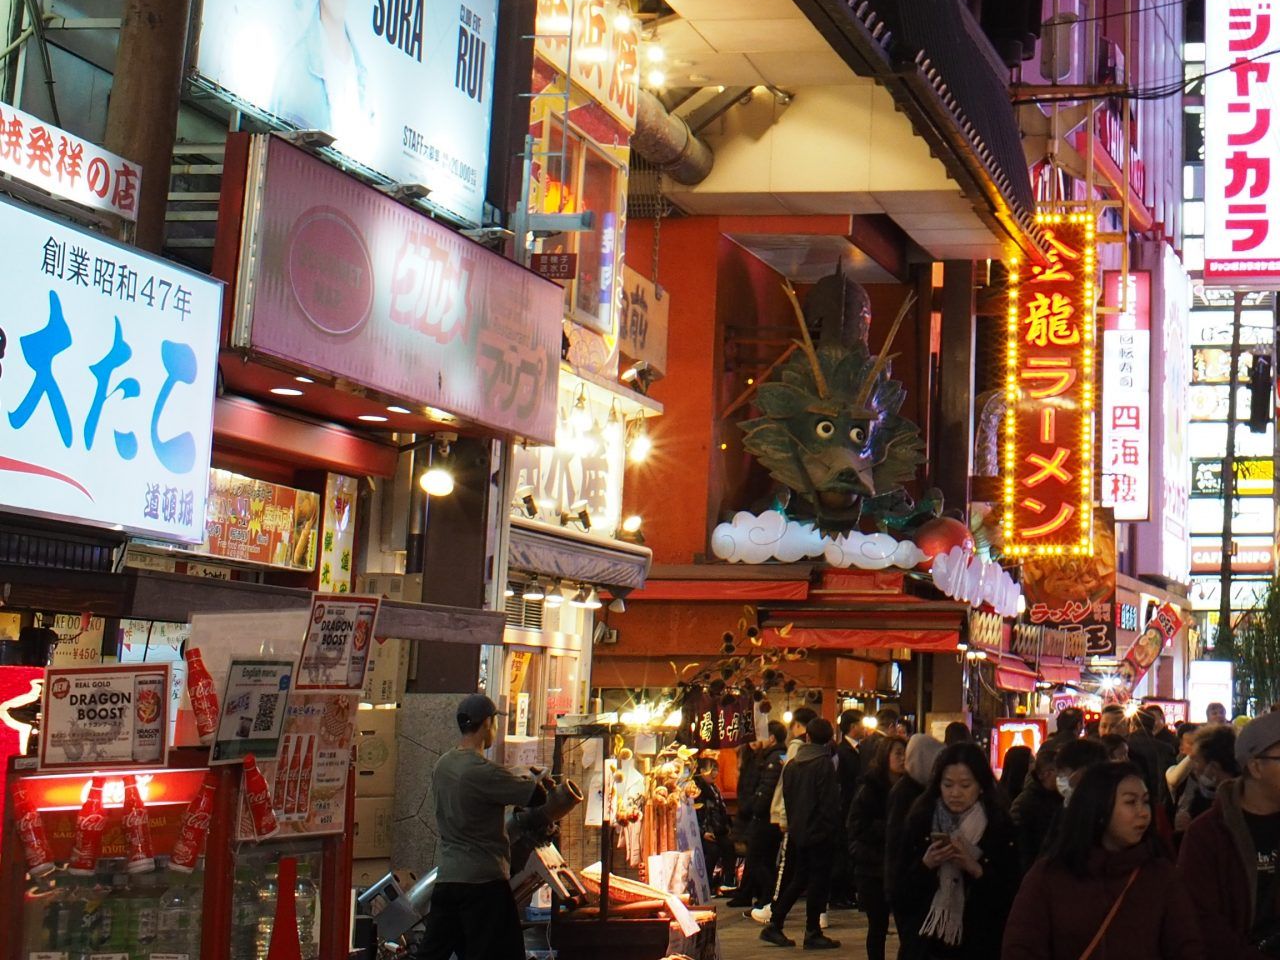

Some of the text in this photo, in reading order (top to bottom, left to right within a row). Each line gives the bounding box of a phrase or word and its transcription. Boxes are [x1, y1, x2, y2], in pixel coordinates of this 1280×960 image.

[459, 3, 482, 32] CLUB EVE
[454, 24, 486, 104] RUI
[1224, 2, 1272, 252] ジャンカラ
[40, 235, 193, 323] 創業昭和47年
[7, 288, 199, 475] 大たこ
[1020, 229, 1080, 539] 金龍ラーメン
[144, 482, 194, 529] 道頓堀
[320, 621, 354, 632] DRAGON
[1029, 596, 1093, 624] ラーメン
[321, 634, 348, 646] BOOST
[70, 692, 132, 706] DRAGON
[77, 707, 124, 721] BOOST
